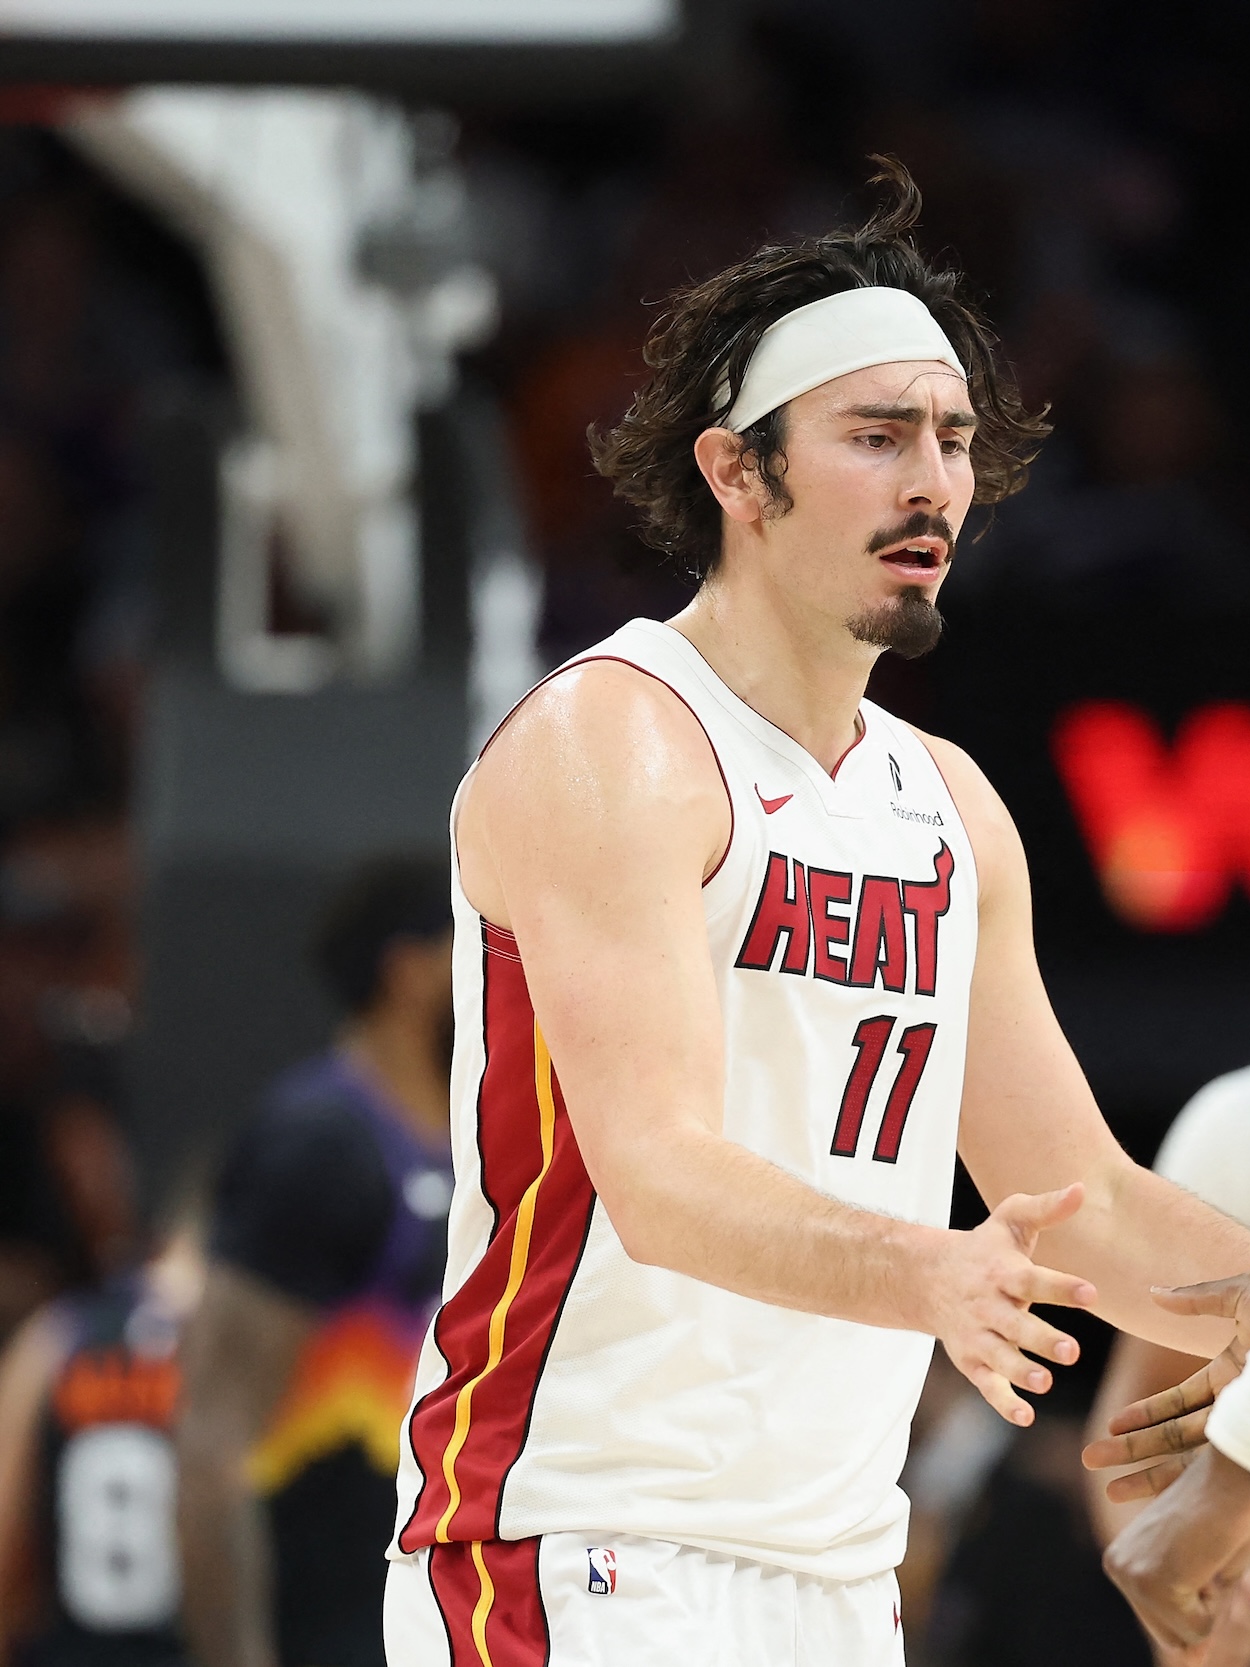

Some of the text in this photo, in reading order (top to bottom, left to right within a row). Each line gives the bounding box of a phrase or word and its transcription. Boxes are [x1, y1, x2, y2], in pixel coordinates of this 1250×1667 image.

[890, 801, 944, 826] Robinhood
[734, 836, 954, 997] HEAT
[830, 1014, 937, 1164] 11
[590, 1581, 606, 1593] NBA
